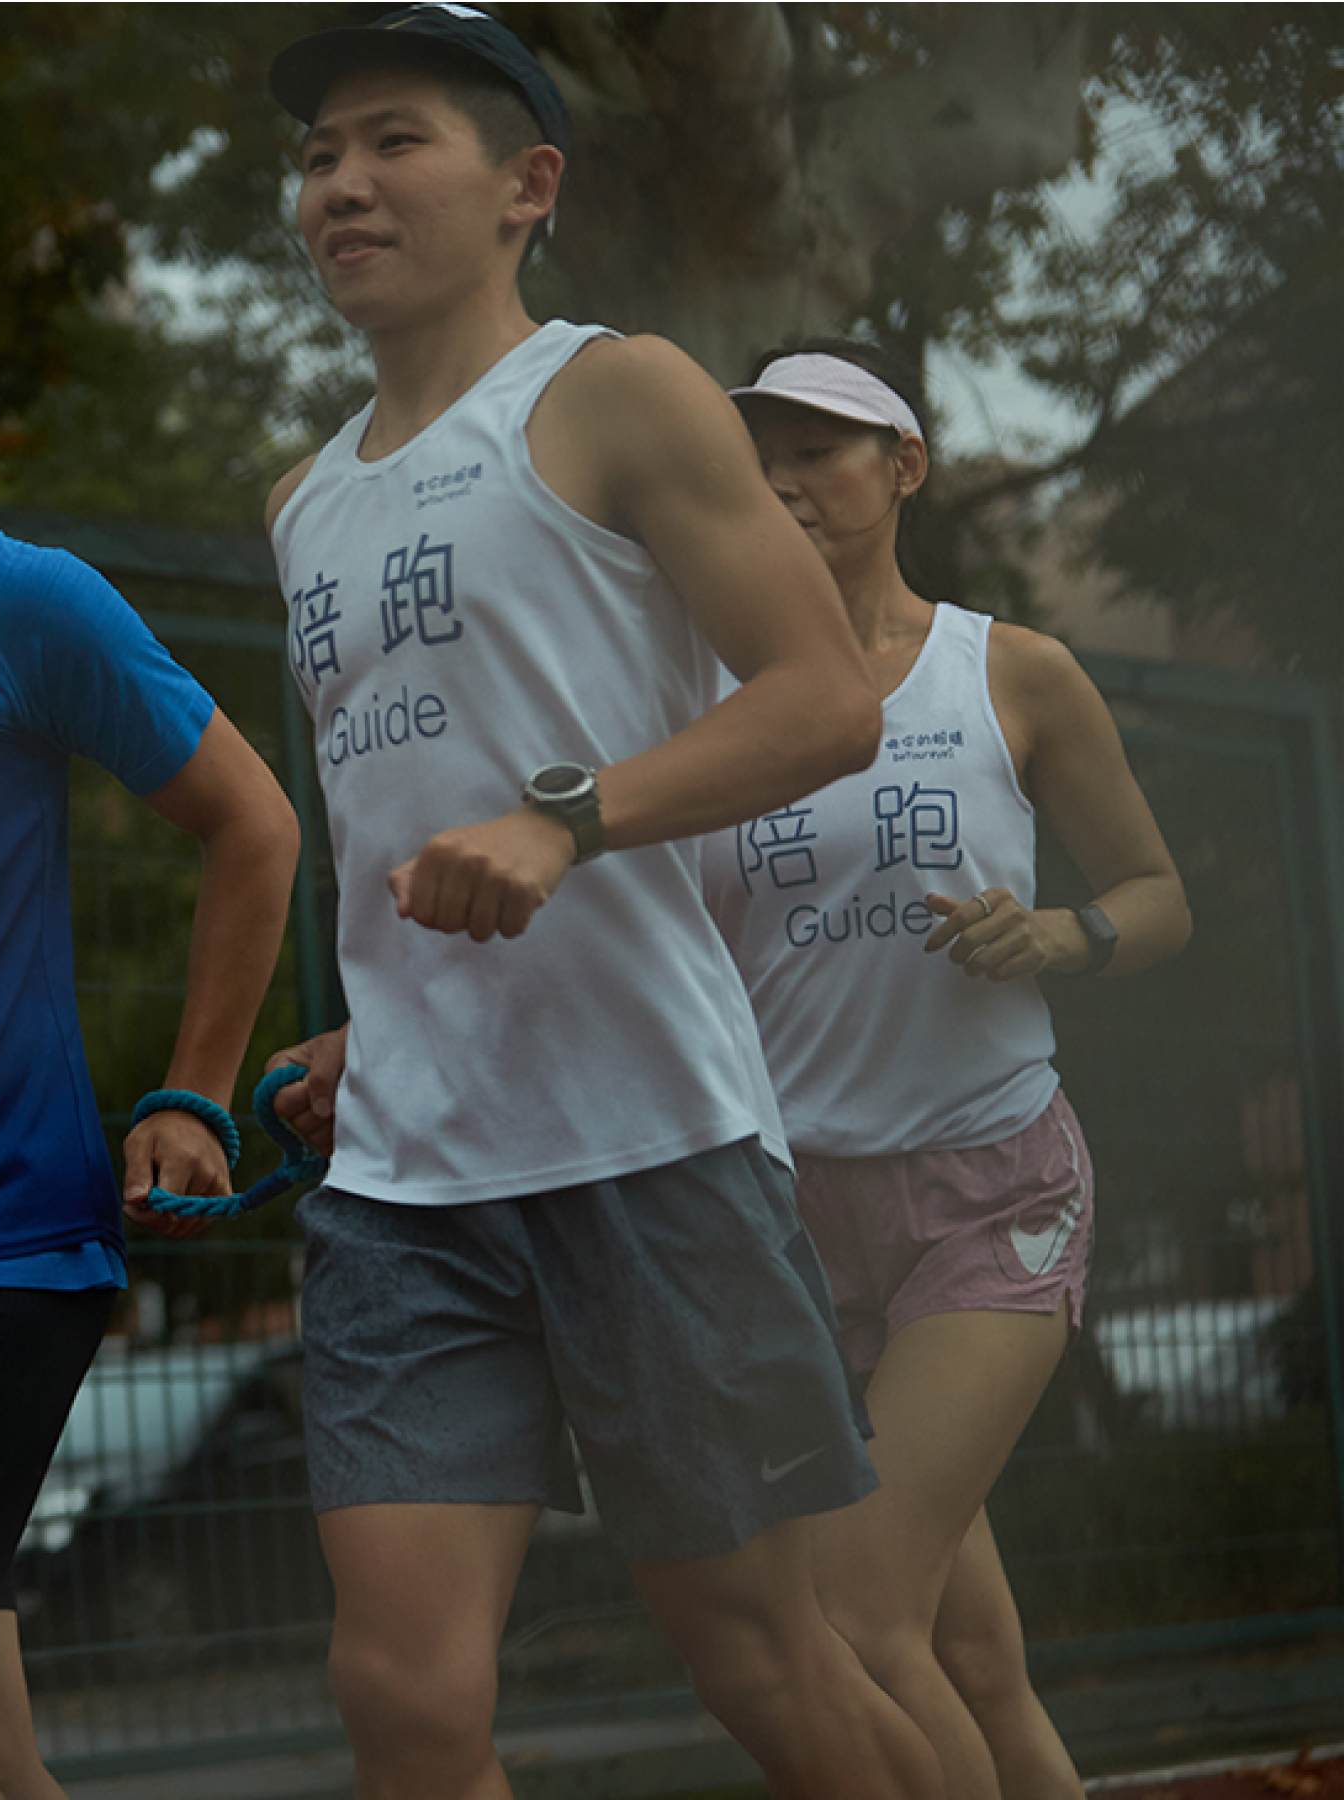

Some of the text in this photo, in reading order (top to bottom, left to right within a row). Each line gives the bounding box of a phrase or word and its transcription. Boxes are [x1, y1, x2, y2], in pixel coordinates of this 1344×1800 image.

[291, 533, 464, 695] 陪跑
[327, 685, 447, 765] Guide
[736, 781, 963, 897] 陪跑
[785, 892, 934, 947] Guide
